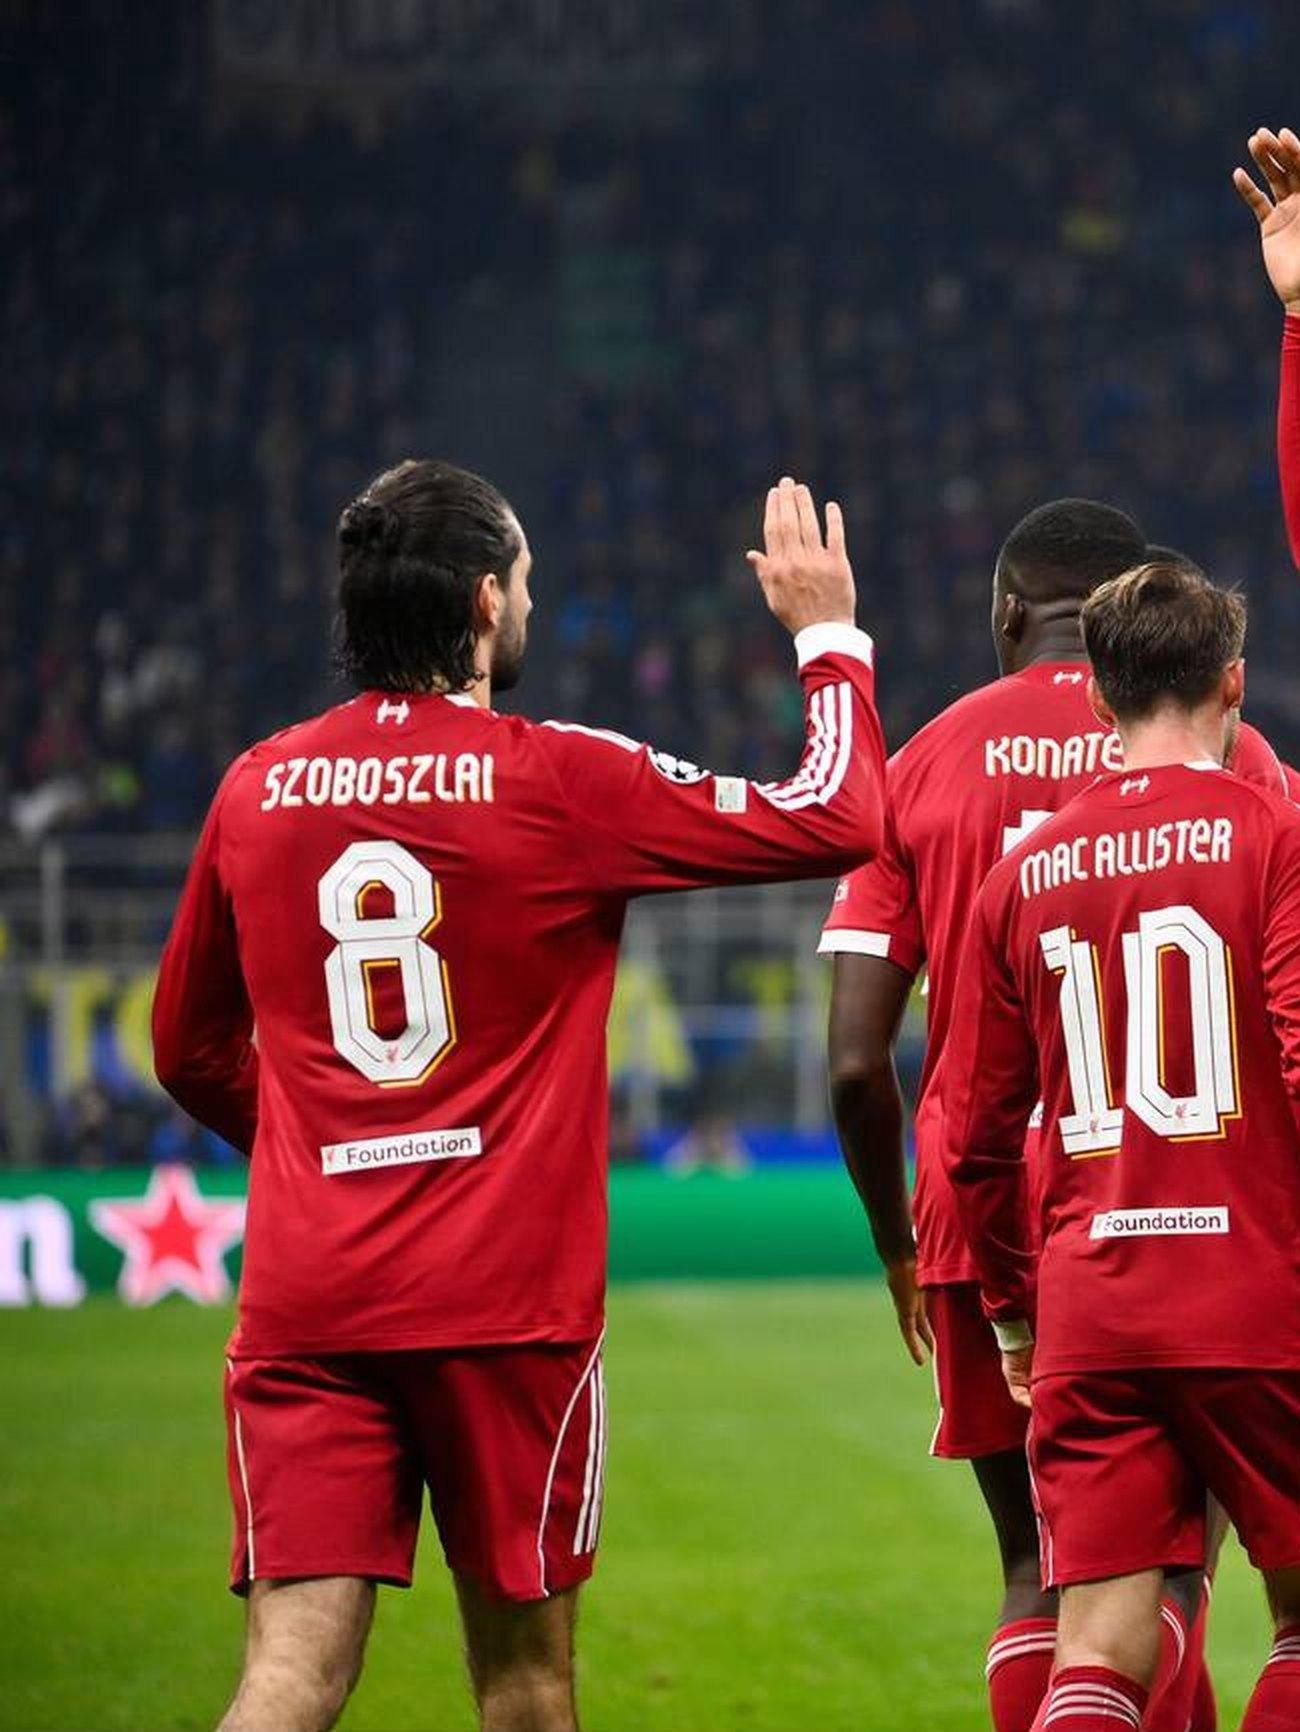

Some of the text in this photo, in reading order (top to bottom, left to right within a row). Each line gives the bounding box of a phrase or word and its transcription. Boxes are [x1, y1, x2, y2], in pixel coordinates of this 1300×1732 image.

[261, 753, 494, 811] SZOBOSZLAI
[1020, 837, 1089, 899] MAC
[1095, 818, 1233, 878] ALLISTER
[318, 840, 458, 1089] 8
[1039, 905, 1242, 1160] 10
[345, 1135, 472, 1165] Foundation
